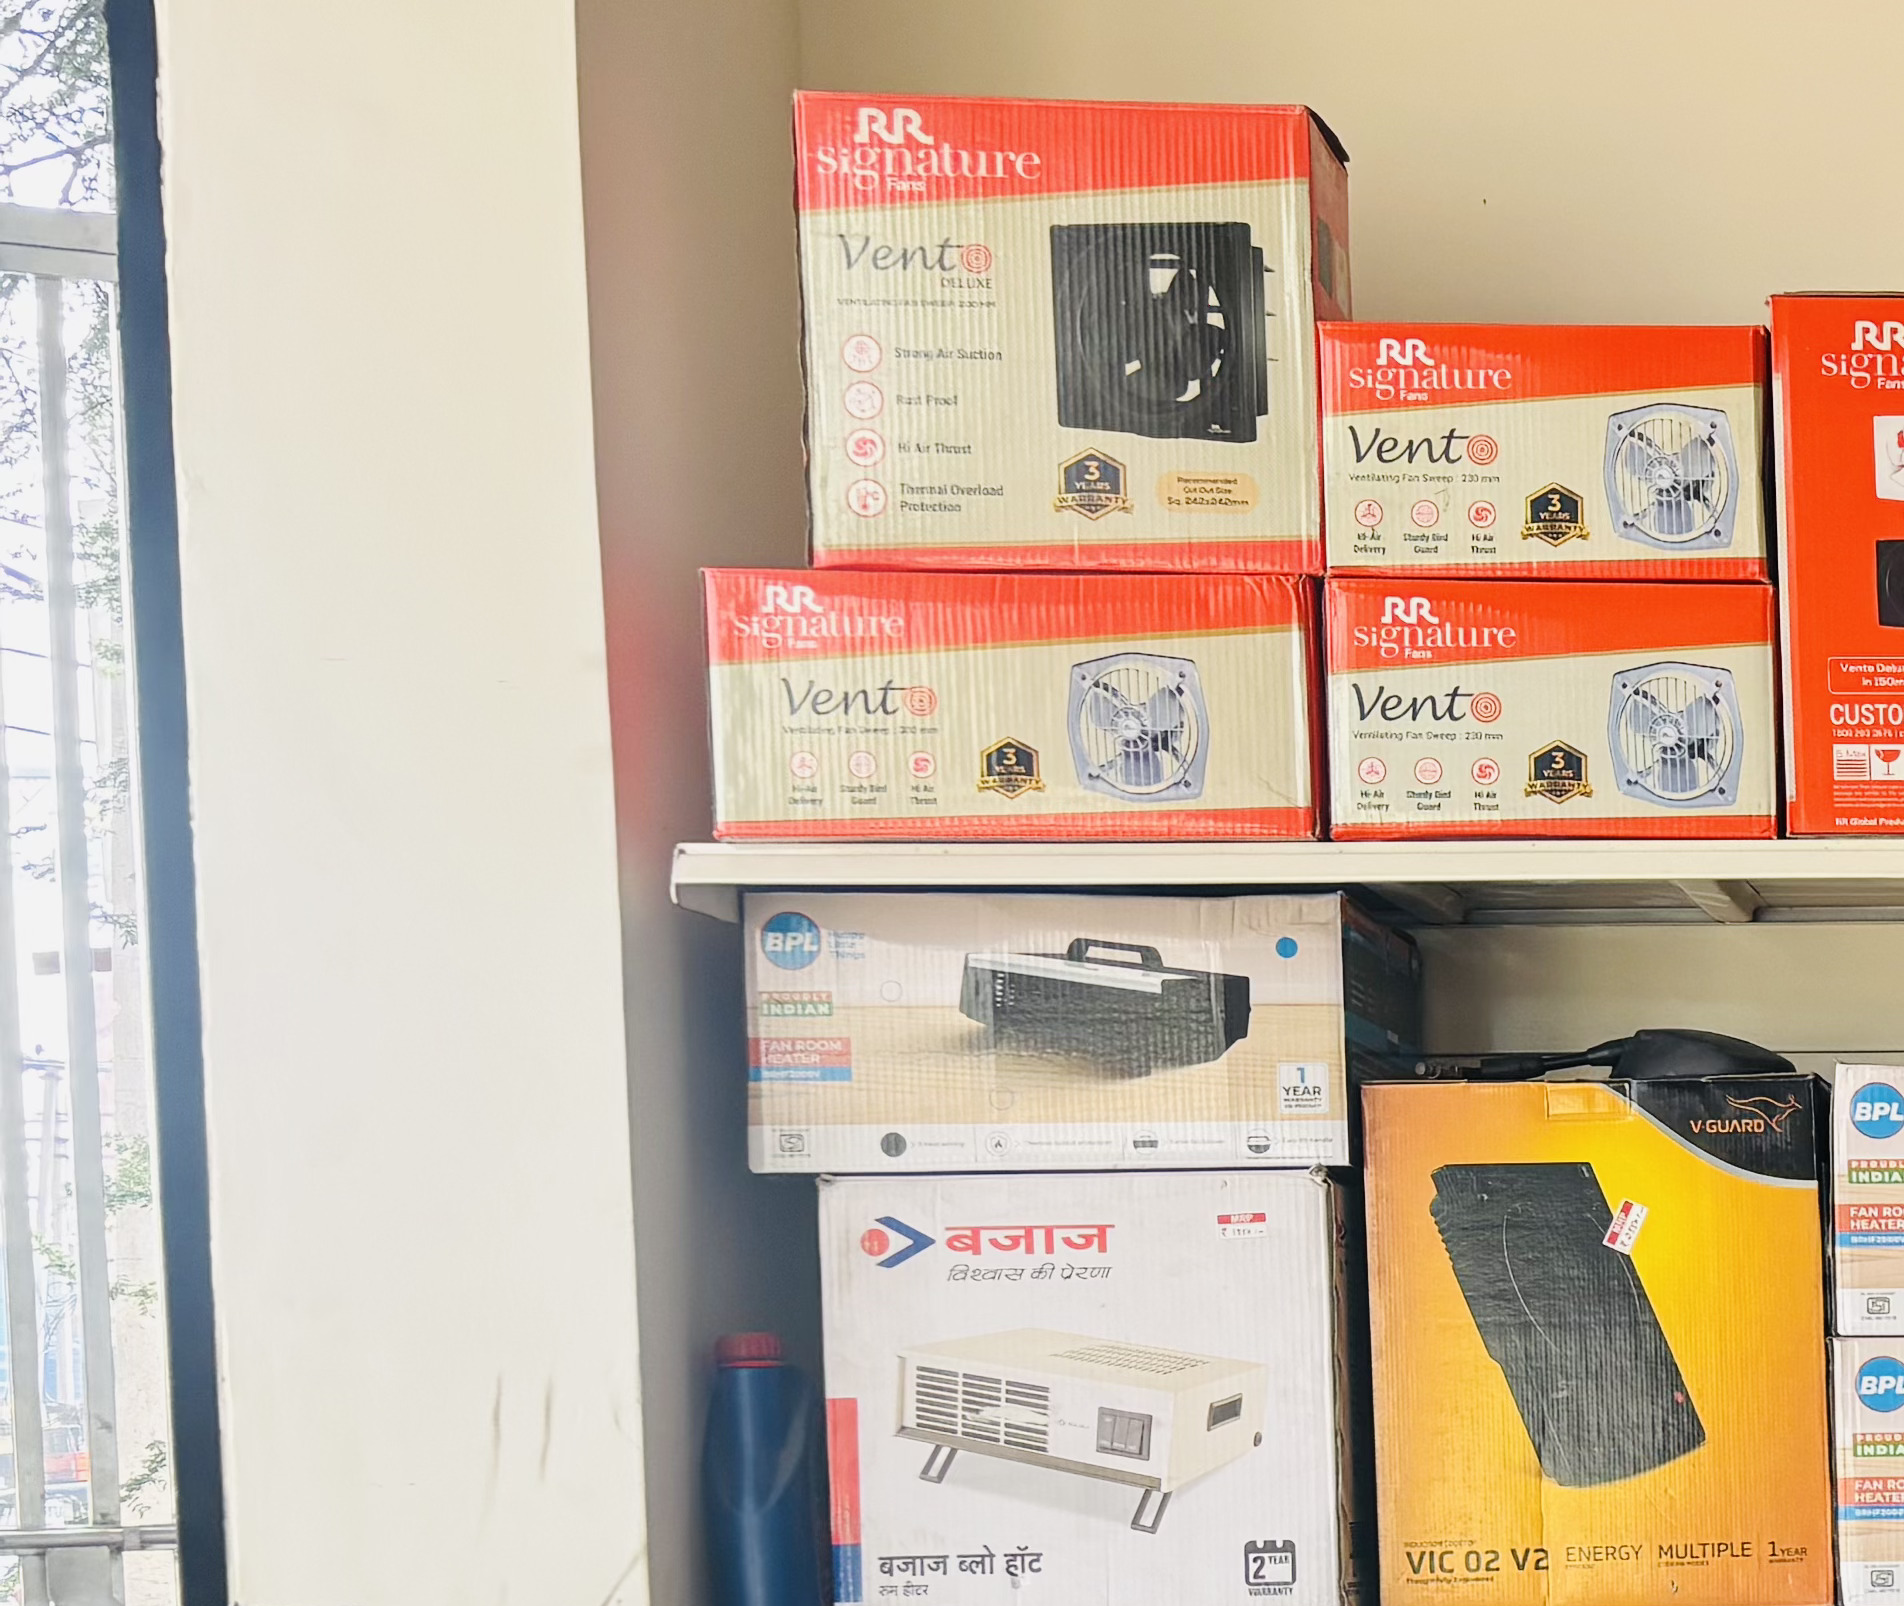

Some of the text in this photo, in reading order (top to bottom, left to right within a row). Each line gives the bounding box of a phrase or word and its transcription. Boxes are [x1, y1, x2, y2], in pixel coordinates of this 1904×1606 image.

[855, 108, 934, 145] RR
[816, 142, 1041, 192] signature
[940, 277, 993, 289] DELUXE
[937, 348, 954, 360] Air
[958, 348, 1002, 361] Suction
[1349, 362, 1511, 400] signature
[1850, 1206, 1877, 1217] FAN
[945, 1224, 1114, 1256] बजाज
[1030, 1263, 1055, 1282] की
[1405, 1549, 1548, 1574] VIC 02 V2
[1566, 1544, 1642, 1563] ENERGY
[1659, 1542, 1752, 1559] MULTIPLE
[878, 1546, 1043, 1578] बजाज ब्लो हॉट
